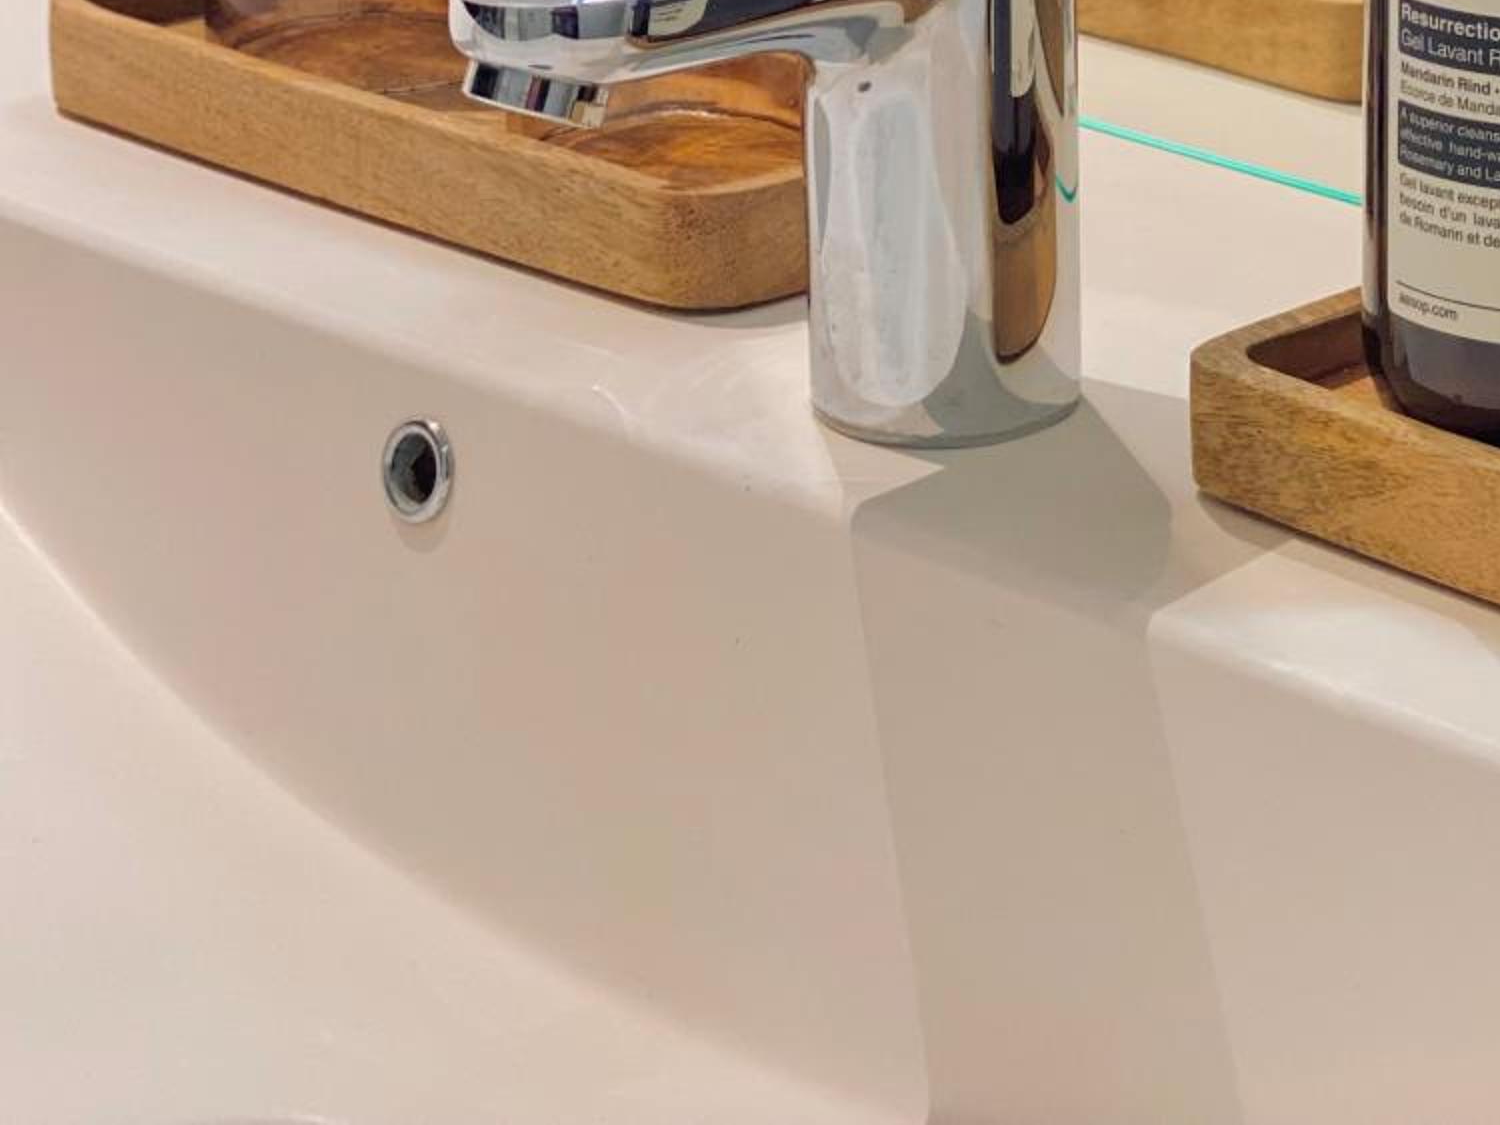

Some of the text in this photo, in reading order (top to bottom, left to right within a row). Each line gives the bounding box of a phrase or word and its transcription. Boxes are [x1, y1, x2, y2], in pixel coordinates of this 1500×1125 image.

[1401, 27, 1425, 51] Gel
[1427, 36, 1484, 67] Lavant
[1400, 60, 1455, 88] Mandarin
[1457, 75, 1491, 96] Rind
[1438, 92, 1454, 109] de
[1409, 112, 1454, 135] superior
[1457, 164, 1481, 179] and
[1419, 179, 1454, 199] lavant
[1400, 192, 1435, 215] besoin
[1439, 206, 1467, 223] d'un
[1466, 233, 1481, 246] et
[1398, 292, 1458, 321] aesop.com
